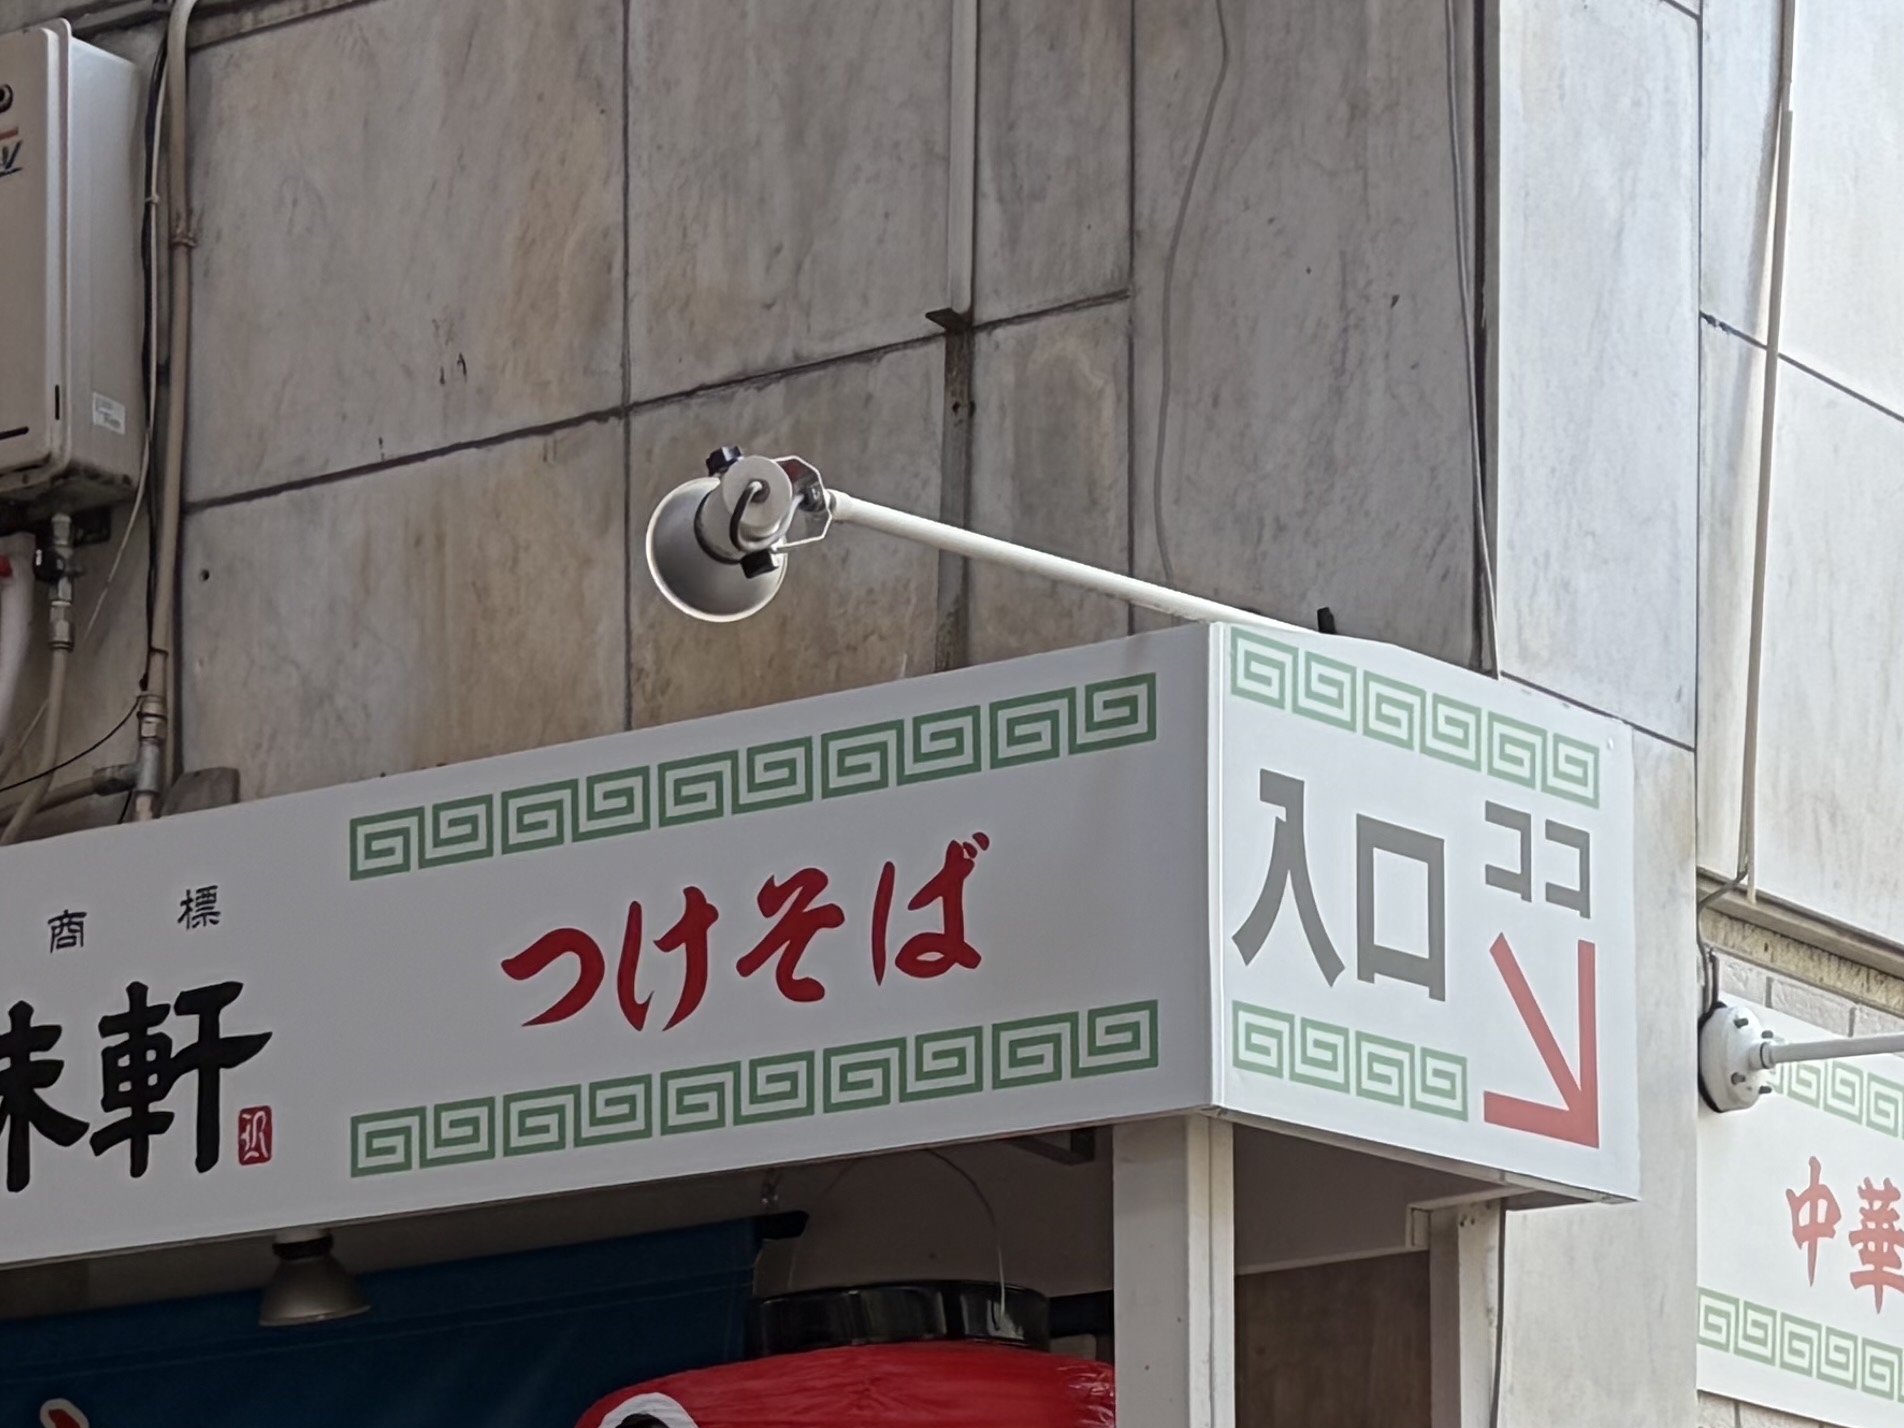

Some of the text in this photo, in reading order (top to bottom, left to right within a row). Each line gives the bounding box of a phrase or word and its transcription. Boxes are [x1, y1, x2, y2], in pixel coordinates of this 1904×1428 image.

[501, 830, 990, 1032] つけそば
[1232, 769, 1592, 1001] 入口 ココ
